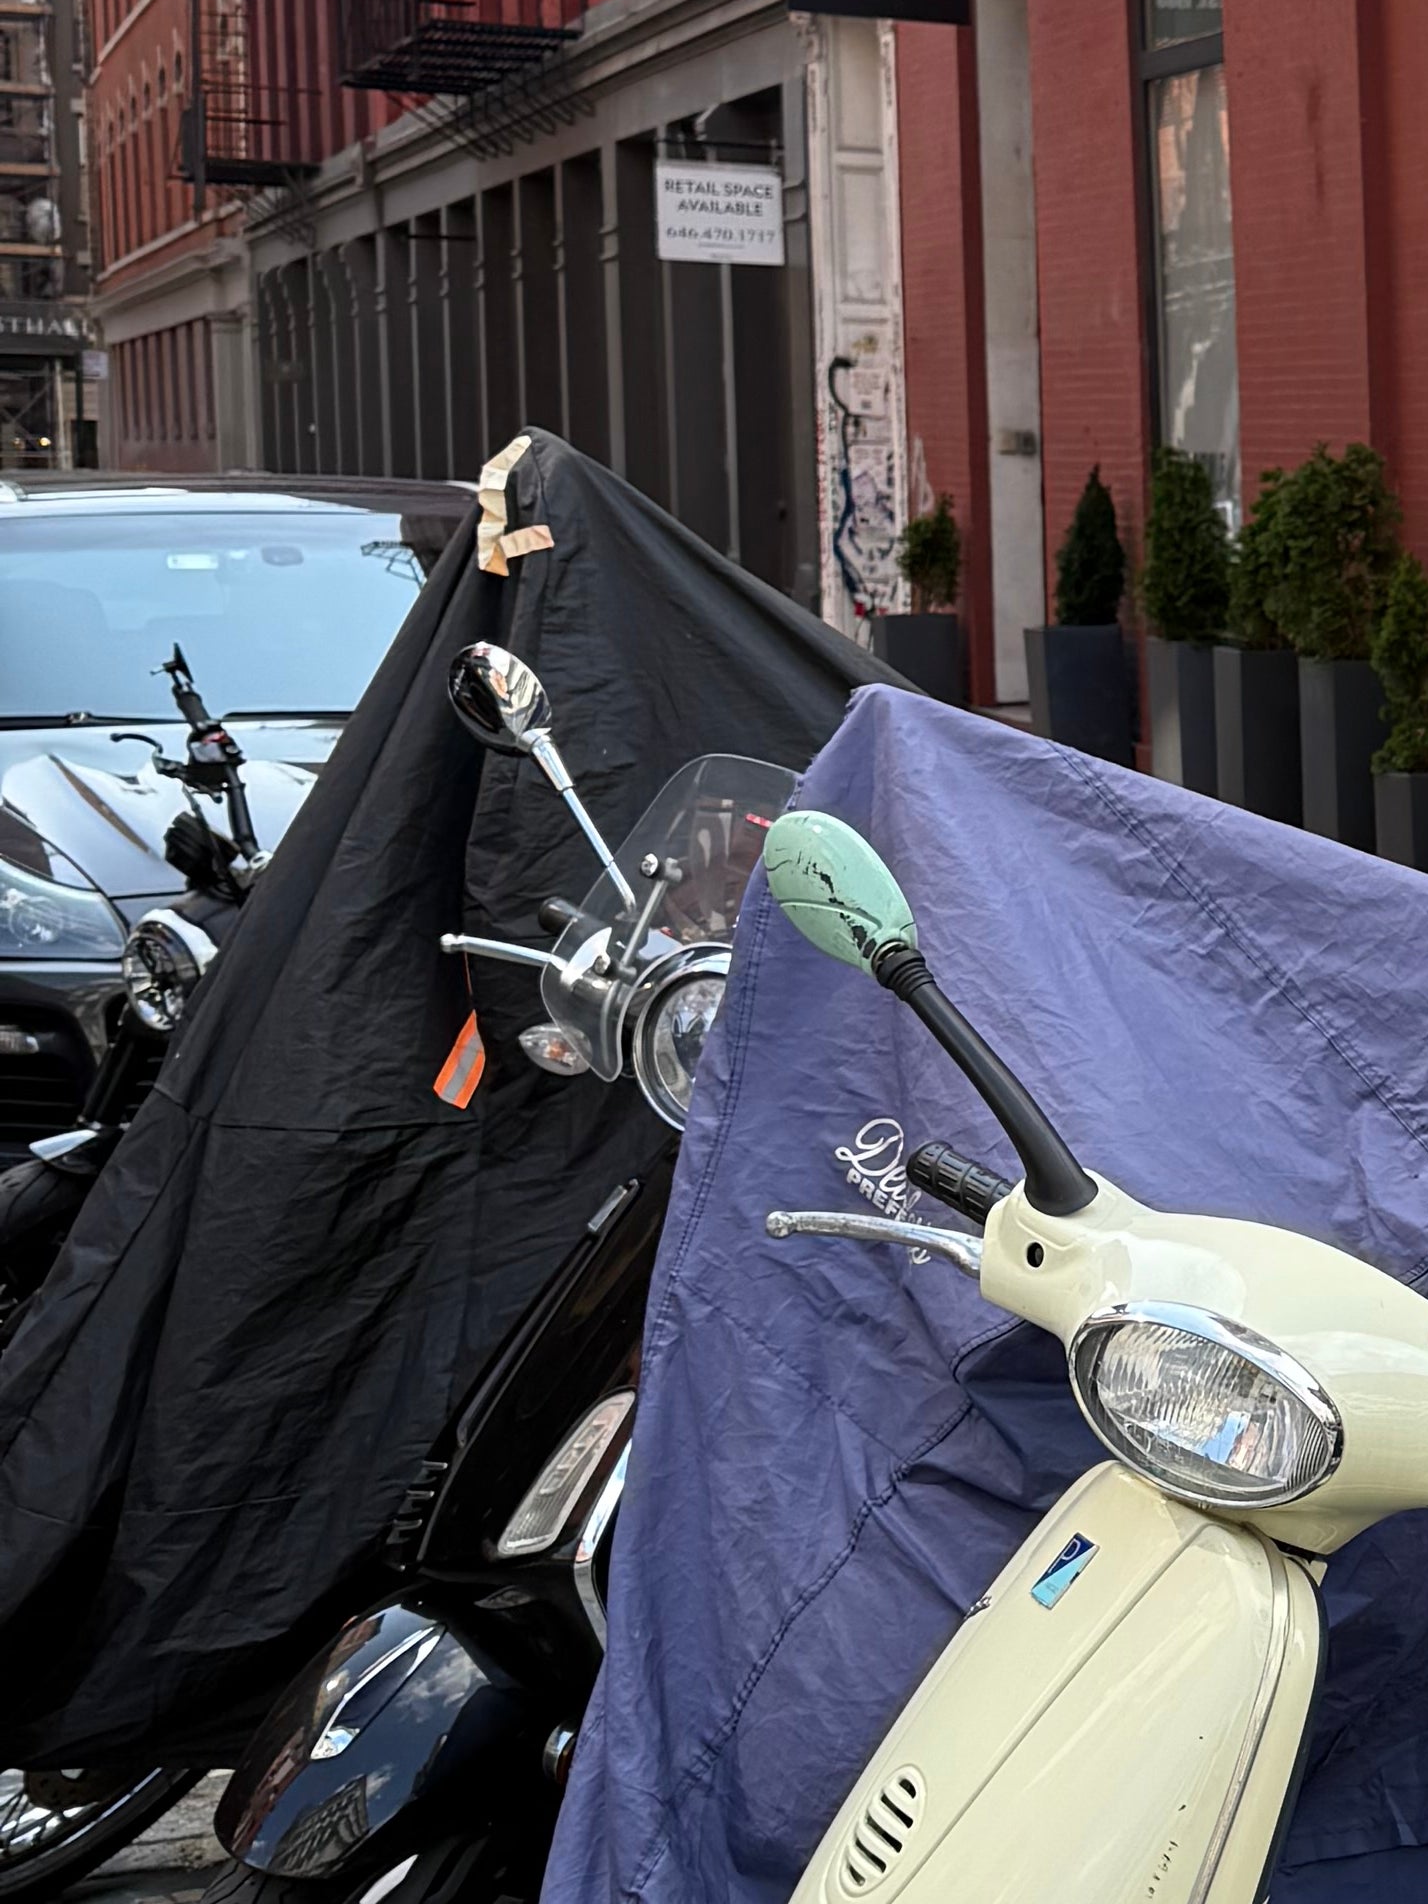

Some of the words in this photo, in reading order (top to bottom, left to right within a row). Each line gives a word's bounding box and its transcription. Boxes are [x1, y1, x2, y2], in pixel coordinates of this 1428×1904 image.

[664, 179, 719, 196] RETAIL
[724, 182, 774, 199] SPACE
[678, 199, 763, 216] AVAILABLE
